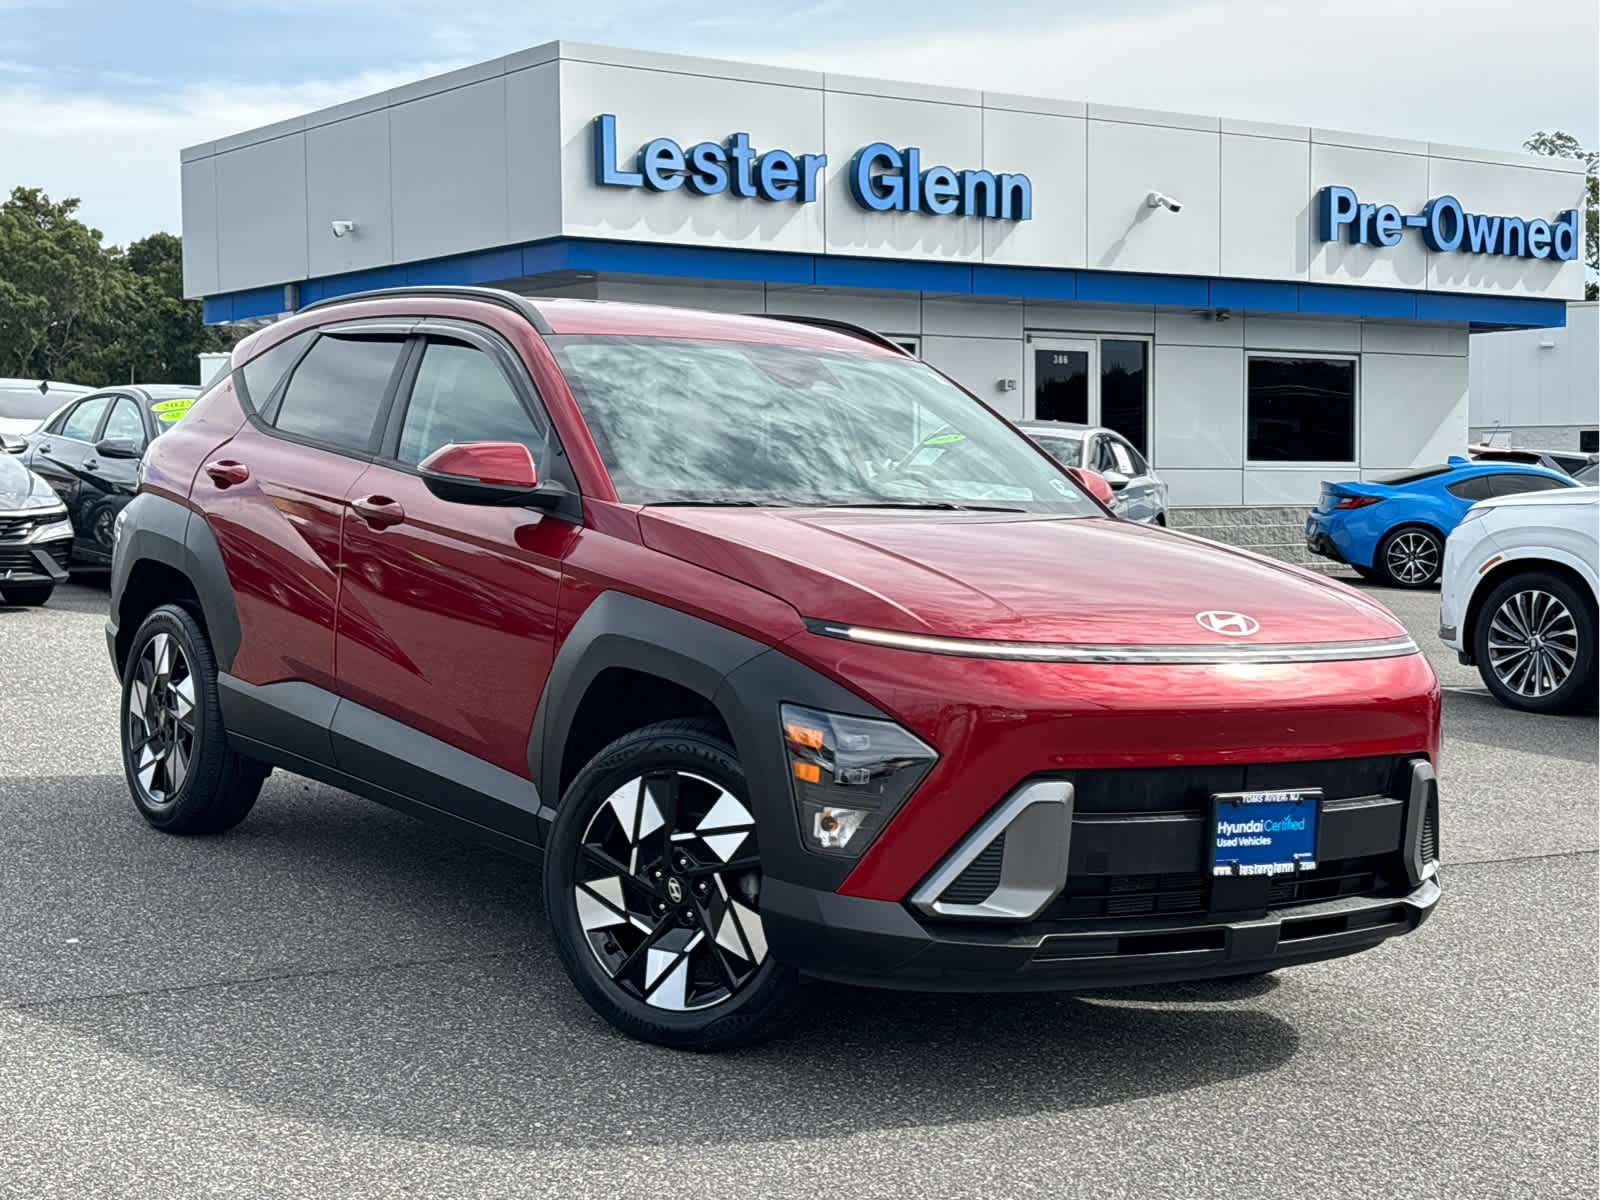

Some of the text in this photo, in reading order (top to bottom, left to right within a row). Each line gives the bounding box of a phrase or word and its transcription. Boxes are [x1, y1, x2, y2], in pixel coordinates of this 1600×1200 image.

[594, 113, 1032, 221] Lester Glenn
[1320, 186, 1578, 260] Pre-Owned
[1217, 836, 1272, 847] Used Vehicles
